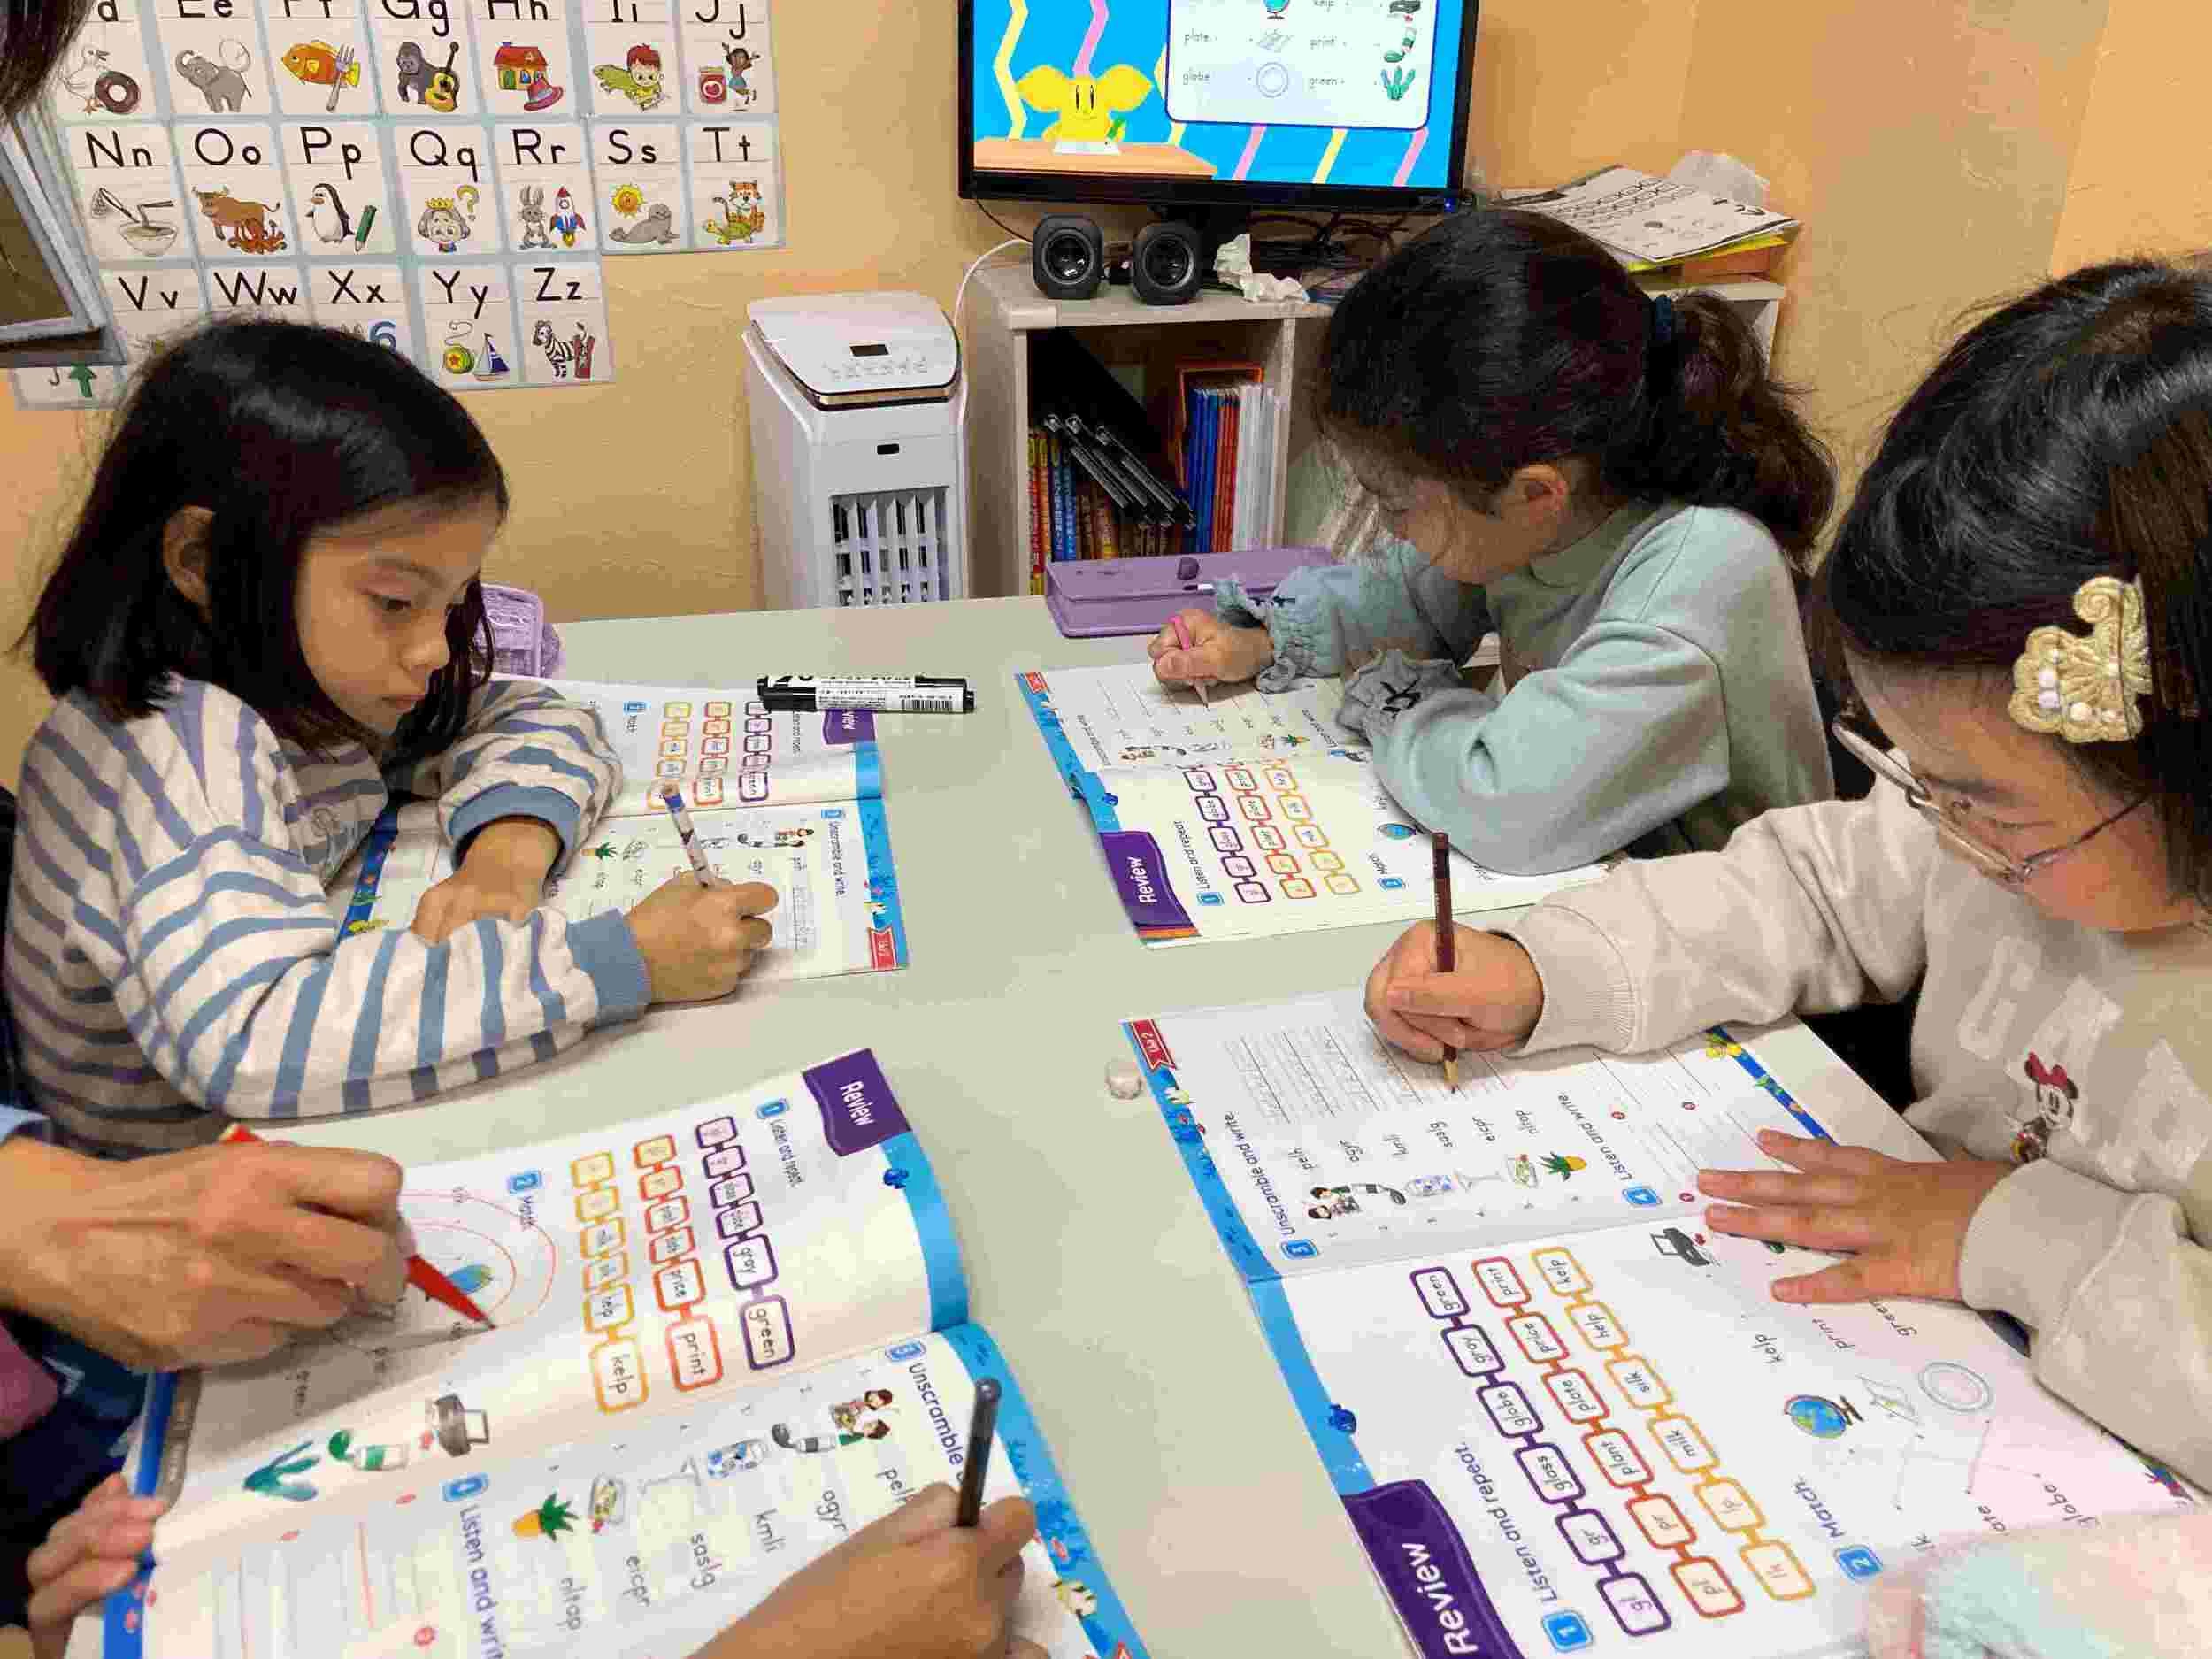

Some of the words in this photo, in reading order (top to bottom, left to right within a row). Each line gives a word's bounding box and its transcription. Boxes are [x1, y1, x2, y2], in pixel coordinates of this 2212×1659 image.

[1184, 846, 1199, 866] and
[1127, 856, 1158, 903] Review
[1194, 864, 1210, 890] Listen
[839, 1080, 875, 1126] Review
[1580, 1122, 1604, 1144] and
[778, 1143, 793, 1162] and
[1235, 1141, 1259, 1165] and
[1601, 1147, 1632, 1181] Listen
[1252, 1166, 1295, 1236] Unscramble
[1486, 1266, 1521, 1297] print
[1548, 1258, 1573, 1285] kelp
[732, 1247, 757, 1275] gray
[748, 1308, 777, 1358] green
[1429, 1274, 1461, 1311] green
[1524, 1322, 1558, 1354] price
[1584, 1313, 1612, 1340] help
[1812, 1317, 1855, 1349] print
[677, 1333, 706, 1374] print
[1463, 1336, 1494, 1364] gray
[1750, 1333, 1784, 1364] kelp
[607, 1354, 634, 1394] kelp
[1623, 1371, 1651, 1394] silk
[1497, 1392, 1533, 1427] globe
[1563, 1379, 1597, 1412] plate
[909, 1363, 964, 1466] Unscramble
[1601, 1440, 1640, 1476] plant
[1664, 1429, 1697, 1458] milk
[1537, 1455, 1574, 1491] glass
[816, 1490, 848, 1532] agyr
[1487, 1508, 1521, 1542] and
[460, 1504, 484, 1563] Listen
[756, 1508, 786, 1552] kmli
[1582, 1529, 1609, 1546] gr
[691, 1533, 723, 1590] saslg
[1515, 1545, 1557, 1603] Listen
[470, 1567, 498, 1612] and
[623, 1555, 651, 1608] eicpr
[1402, 1543, 1479, 1654] Review
[556, 1578, 588, 1631] nltap
[1619, 1596, 1653, 1612] gl
